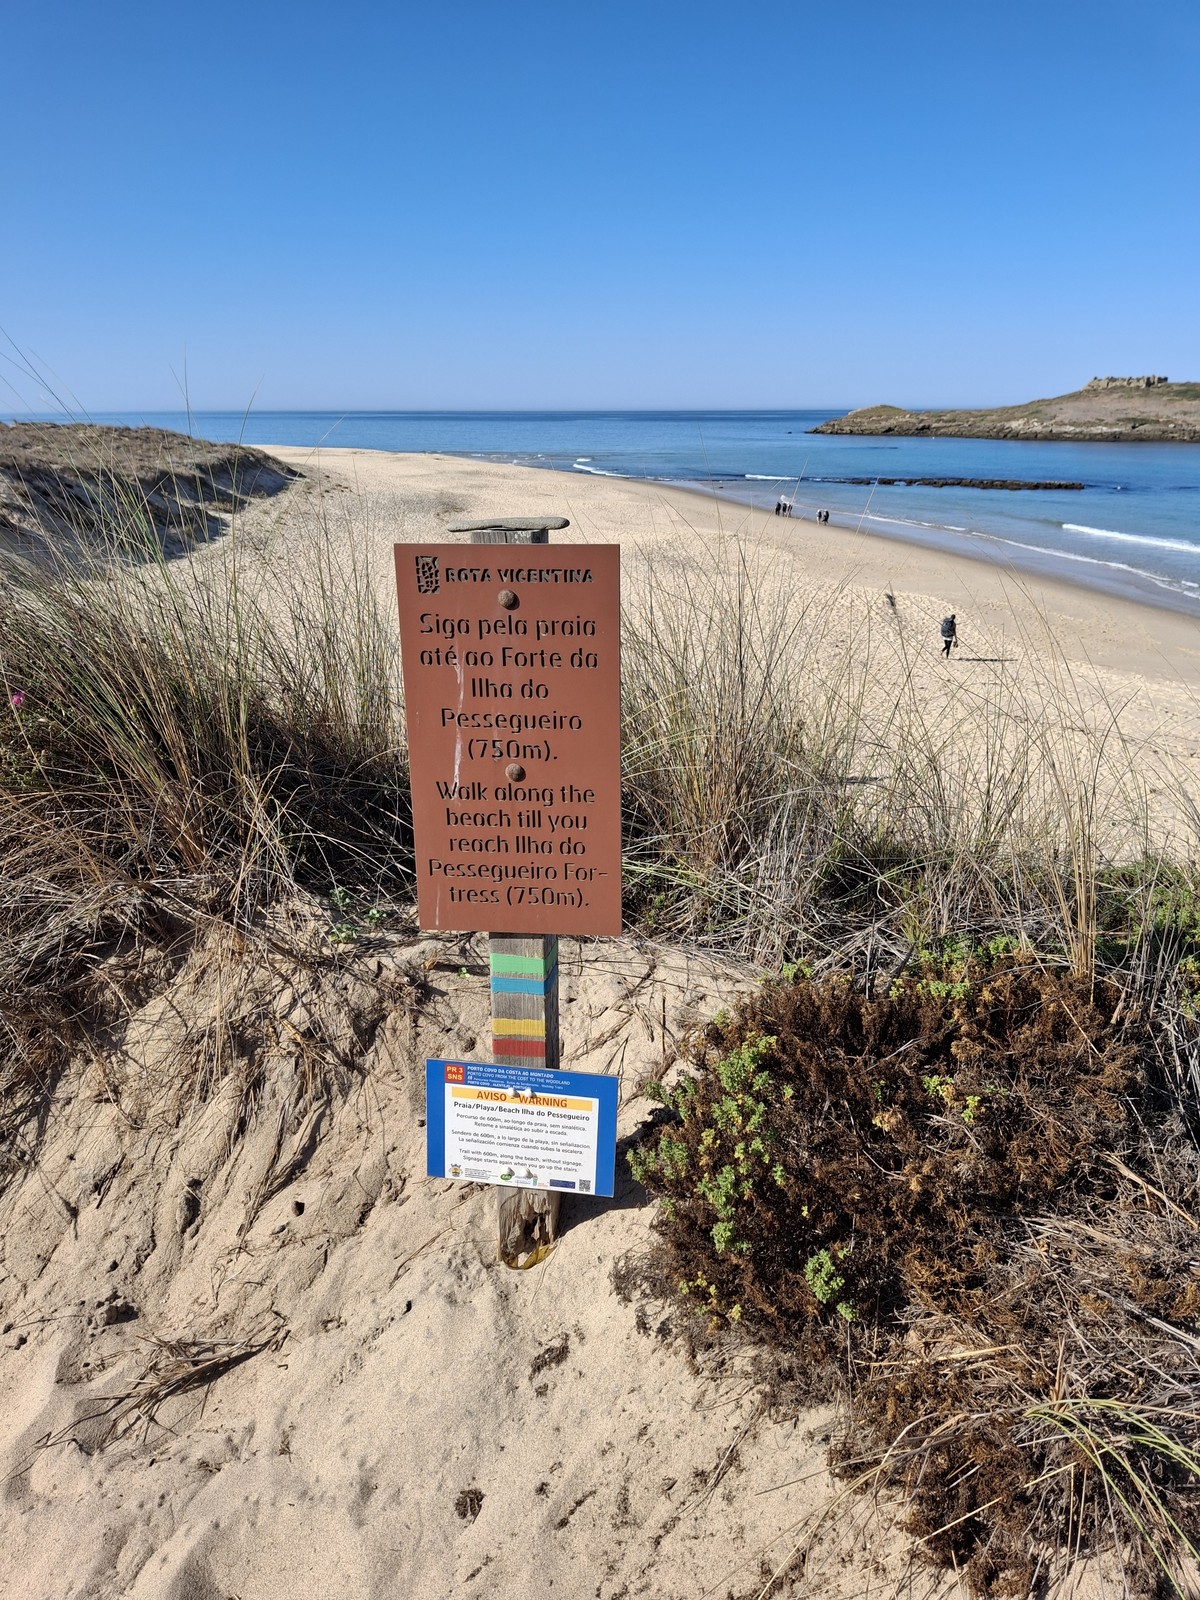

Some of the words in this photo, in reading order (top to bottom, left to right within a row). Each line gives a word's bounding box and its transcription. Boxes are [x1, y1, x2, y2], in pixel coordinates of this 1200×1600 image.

[445, 568, 492, 582] ROTA
[497, 568, 594, 583] VICENTINA
[420, 614, 470, 639] Siga
[478, 615, 528, 640] pela
[536, 616, 596, 640] praia
[420, 645, 457, 666] até
[465, 650, 494, 666] ao
[502, 647, 562, 668] Forte
[570, 648, 598, 668] da
[472, 678, 512, 698] Ilha
[521, 679, 548, 699] do
[442, 708, 582, 734] Pessegueiro
[468, 739, 558, 760] (750m).
[436, 782, 488, 800] Walk
[494, 783, 554, 806] along
[560, 785, 595, 802] the
[446, 808, 510, 828] beach
[518, 810, 541, 828] till
[548, 815, 587, 832] you
[450, 836, 508, 853] reach
[516, 836, 552, 854] Ilha
[560, 837, 586, 855] do
[429, 859, 557, 882] Pessegueiro
[564, 862, 608, 881] For-
[450, 886, 500, 903] tress
[506, 886, 589, 908] (750m).
[477, 1091, 506, 1102] AVISO
[520, 1095, 568, 1108] WARNING
[454, 1102, 520, 1114] Praia/Playa/Beach
[548, 1111, 590, 1121] Pessegueiro
